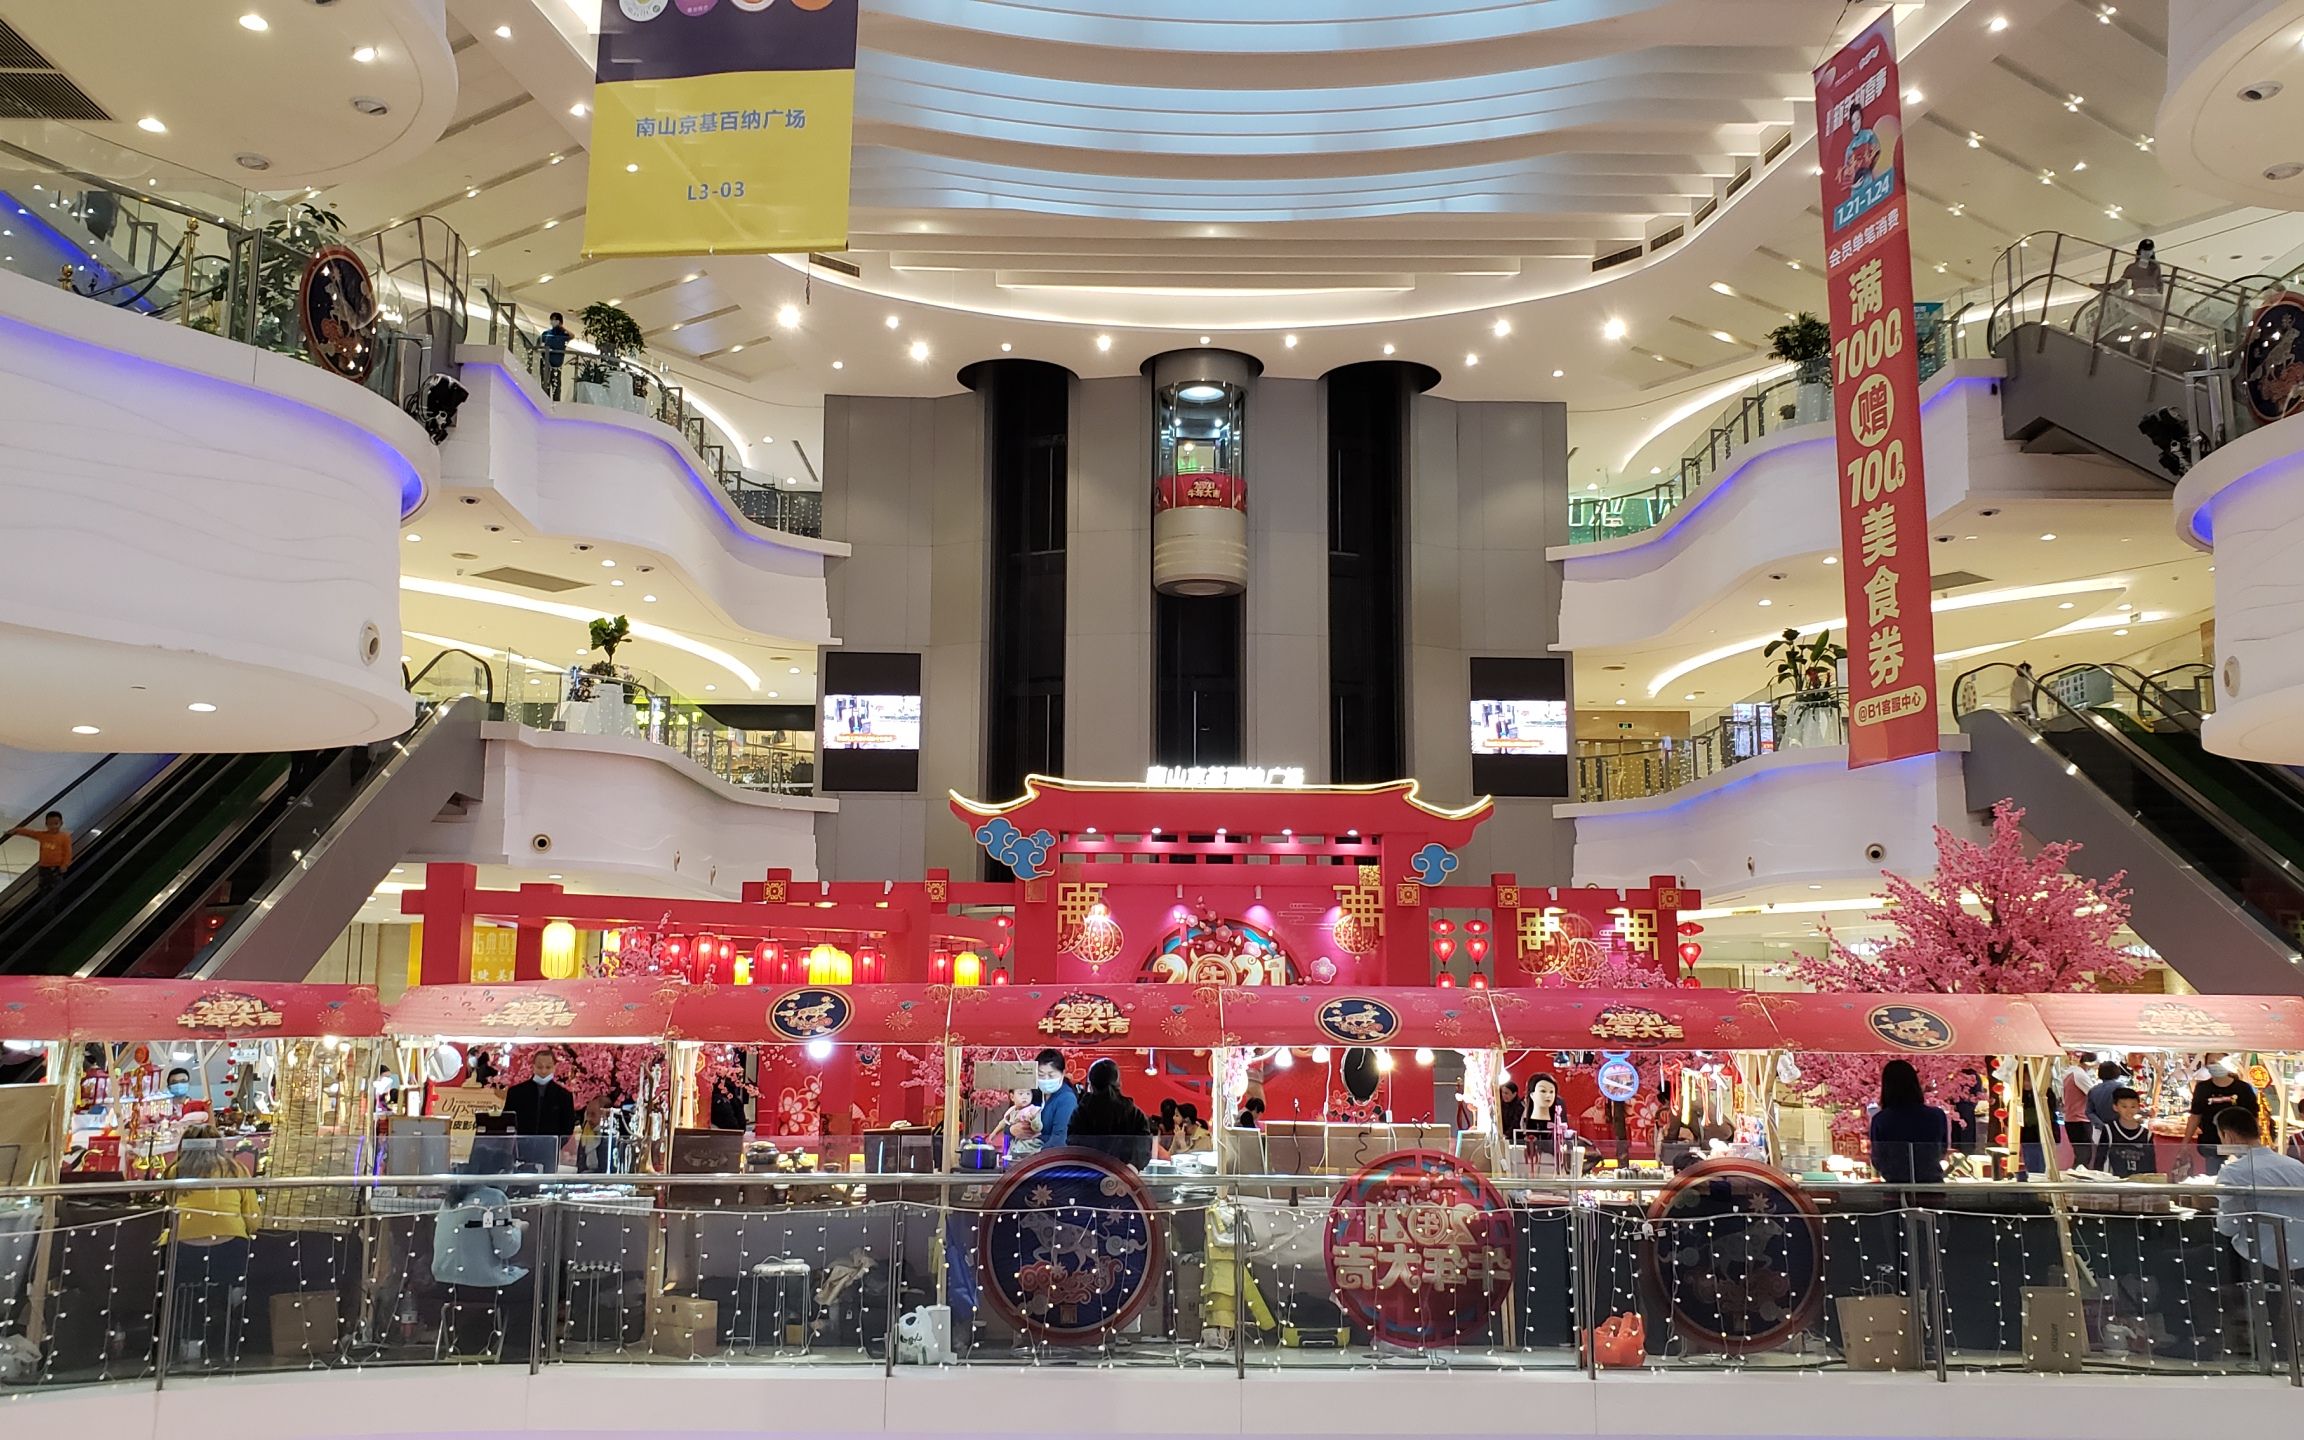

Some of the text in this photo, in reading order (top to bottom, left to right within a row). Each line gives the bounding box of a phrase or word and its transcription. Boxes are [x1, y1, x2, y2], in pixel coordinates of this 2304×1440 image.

[635, 108, 807, 138] 南山京基百纳广场
[687, 181, 745, 200] L3-03
[1829, 208, 1900, 268] 会员单笔消费
[1849, 258, 1883, 325] 满
[1835, 308, 1902, 385] 1000
[1847, 439, 1905, 508] 100
[1861, 502, 1904, 688] 美食券
[1857, 691, 1922, 723] @B1客服中心
[176, 1012, 283, 1028] 牛年大吉
[1038, 1016, 1131, 1034] 牛年大吉
[1054, 1001, 1115, 1018] 2021
[1589, 1024, 1684, 1038] 牛年大吉
